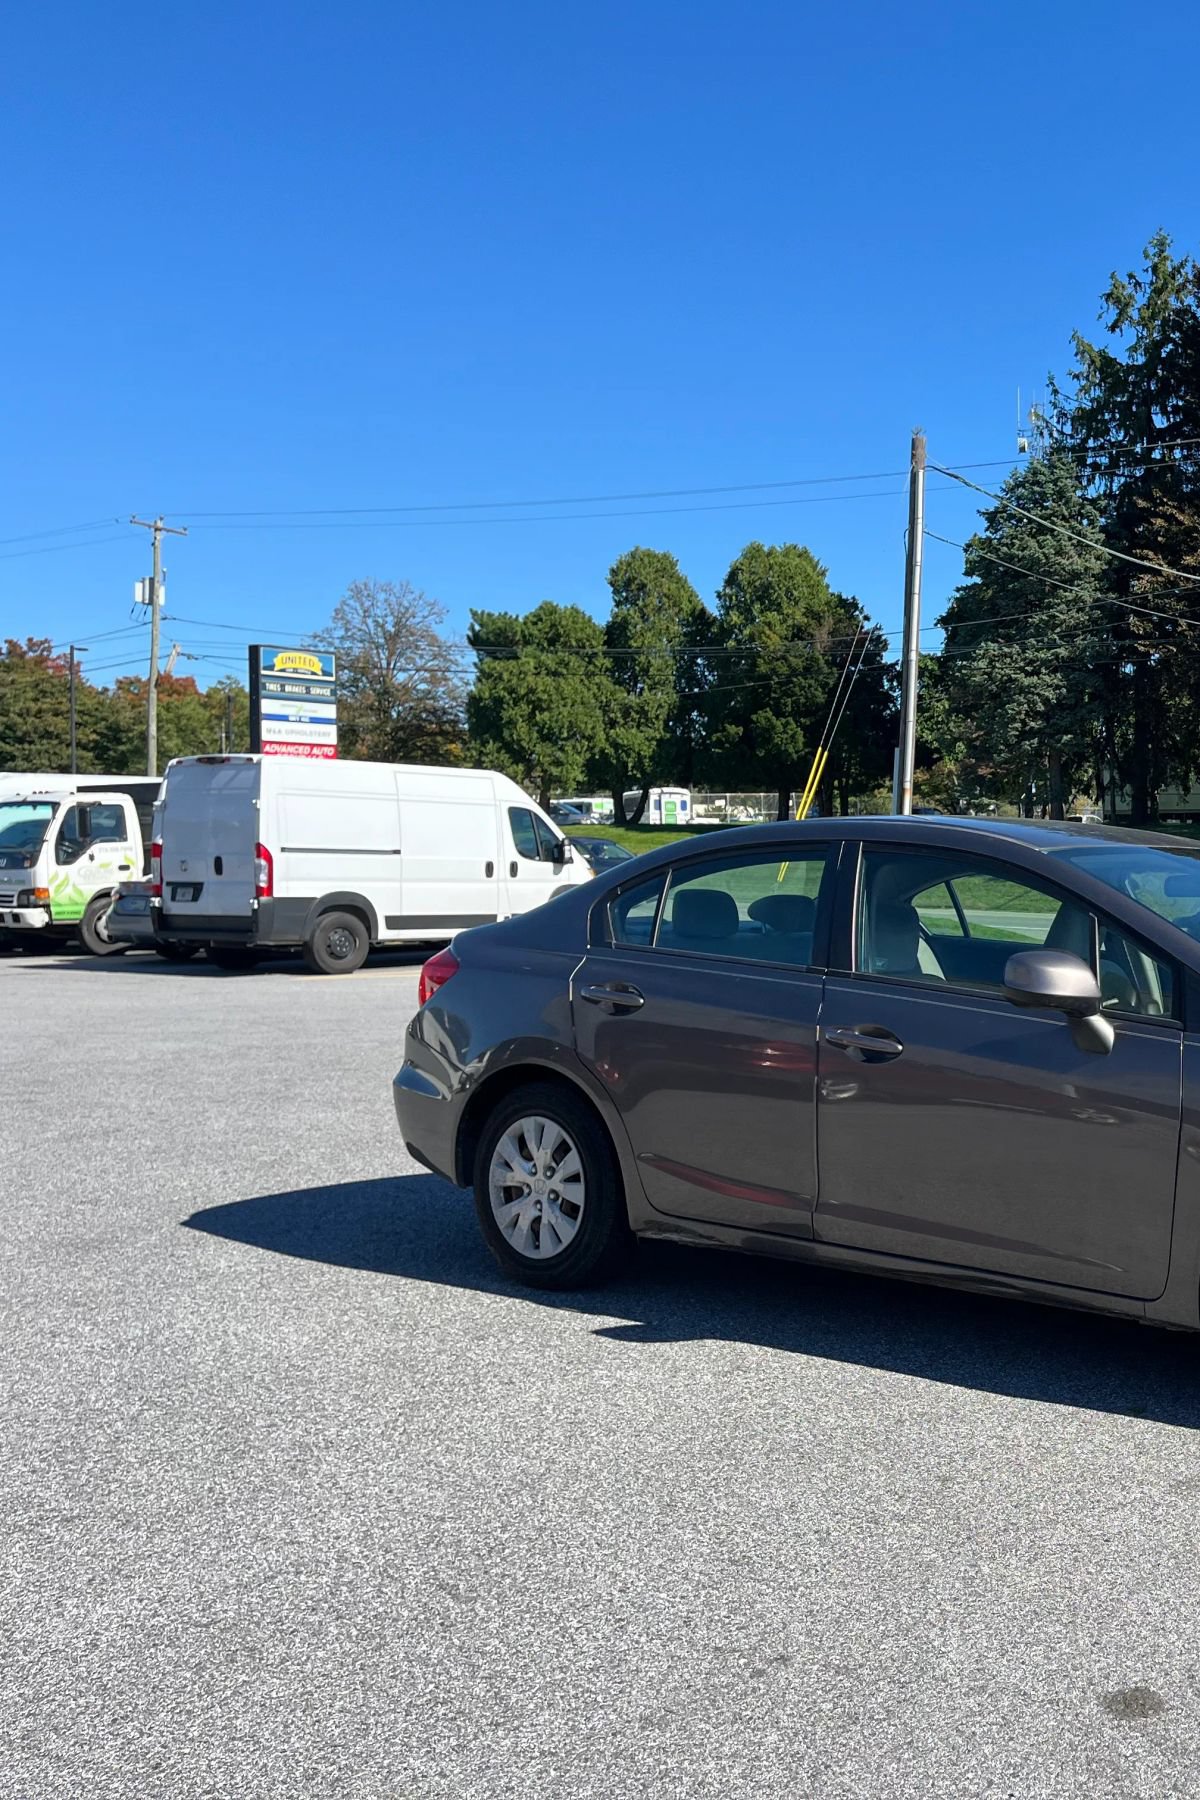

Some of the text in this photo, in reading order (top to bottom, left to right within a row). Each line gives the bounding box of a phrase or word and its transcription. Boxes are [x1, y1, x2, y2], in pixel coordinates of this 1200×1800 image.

[281, 655, 315, 668] UNITED
[265, 682, 331, 697] TIRES BRAKES SERVICE
[285, 728, 331, 738] UPHOLSTERY
[263, 743, 310, 755] ADVANCED
[311, 746, 335, 757] AUTO
